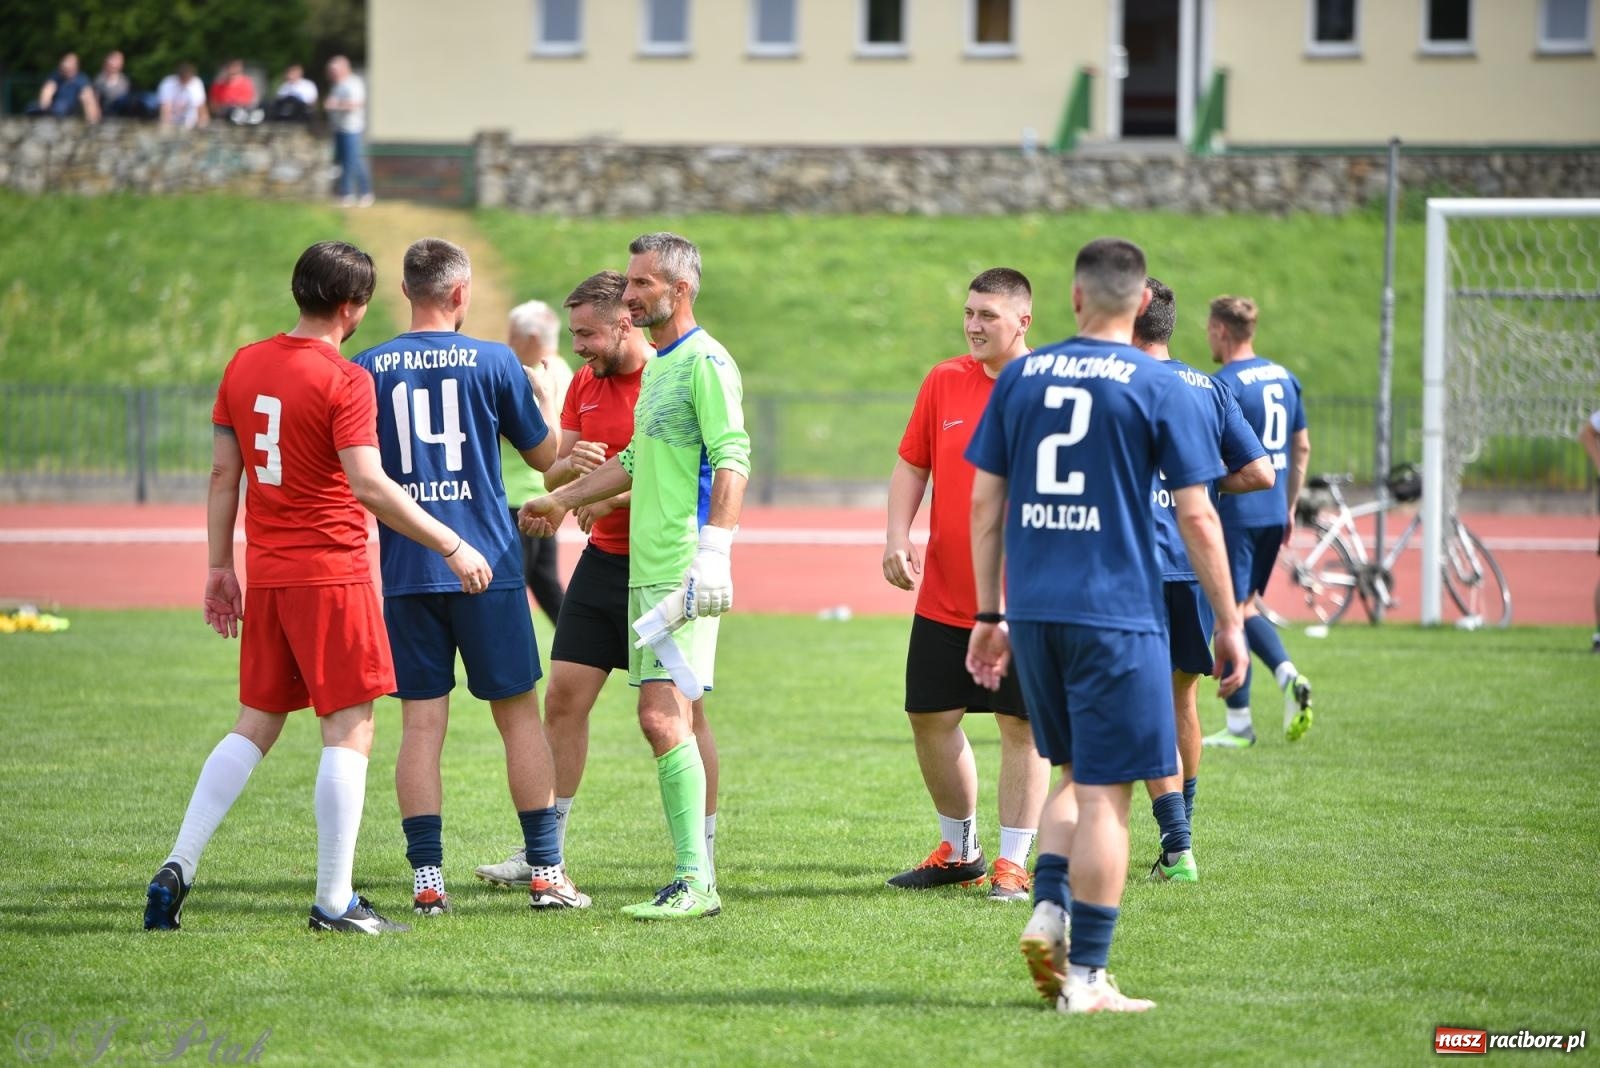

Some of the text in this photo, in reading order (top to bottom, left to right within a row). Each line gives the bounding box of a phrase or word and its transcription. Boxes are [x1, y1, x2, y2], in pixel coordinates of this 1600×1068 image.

[375, 344, 478, 373] KPP RACIBÓRZ
[1022, 354, 1054, 377] KPP
[253, 393, 282, 487] 3
[391, 378, 467, 475] 14
[1036, 385, 1093, 496] 2
[1262, 383, 1287, 450] 6
[1021, 503, 1101, 532] POLICJA
